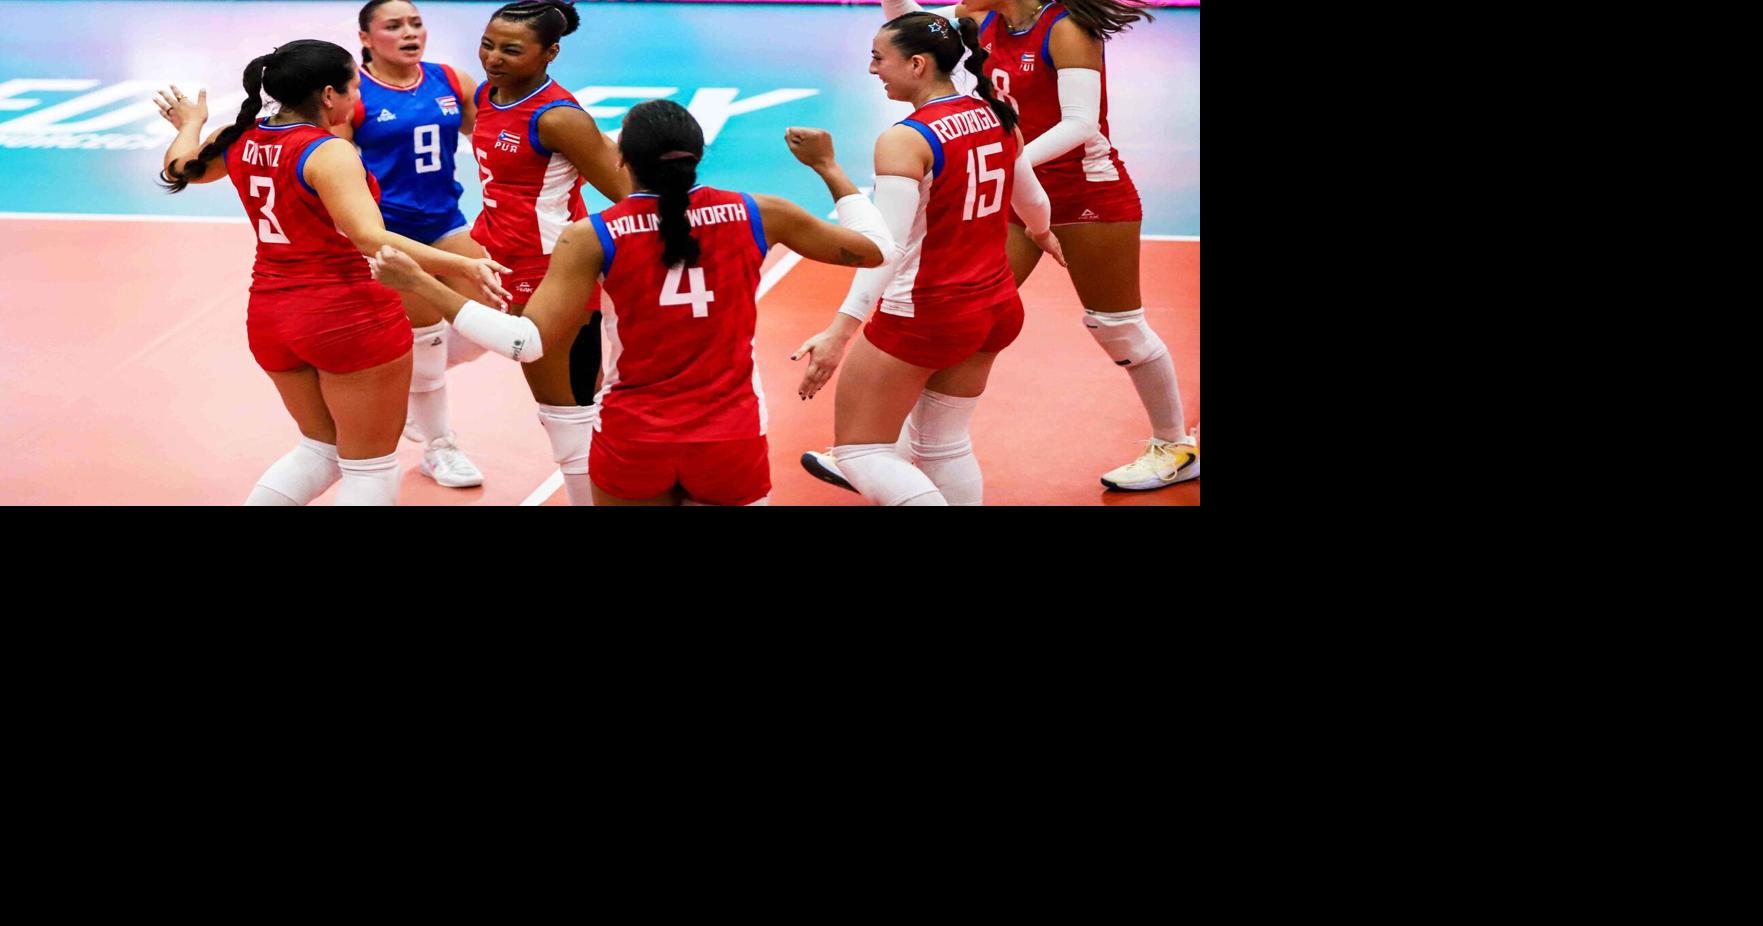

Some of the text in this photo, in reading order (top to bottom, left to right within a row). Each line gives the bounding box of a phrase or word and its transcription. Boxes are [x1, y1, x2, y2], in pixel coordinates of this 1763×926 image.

[413, 124, 442, 174] 9
[494, 141, 518, 153] PUR
[928, 106, 1000, 144] RODRIGU
[962, 141, 1006, 221] 15
[249, 175, 291, 244] 3
[606, 203, 747, 240] HOLLINWORTH
[659, 260, 715, 318] 4
